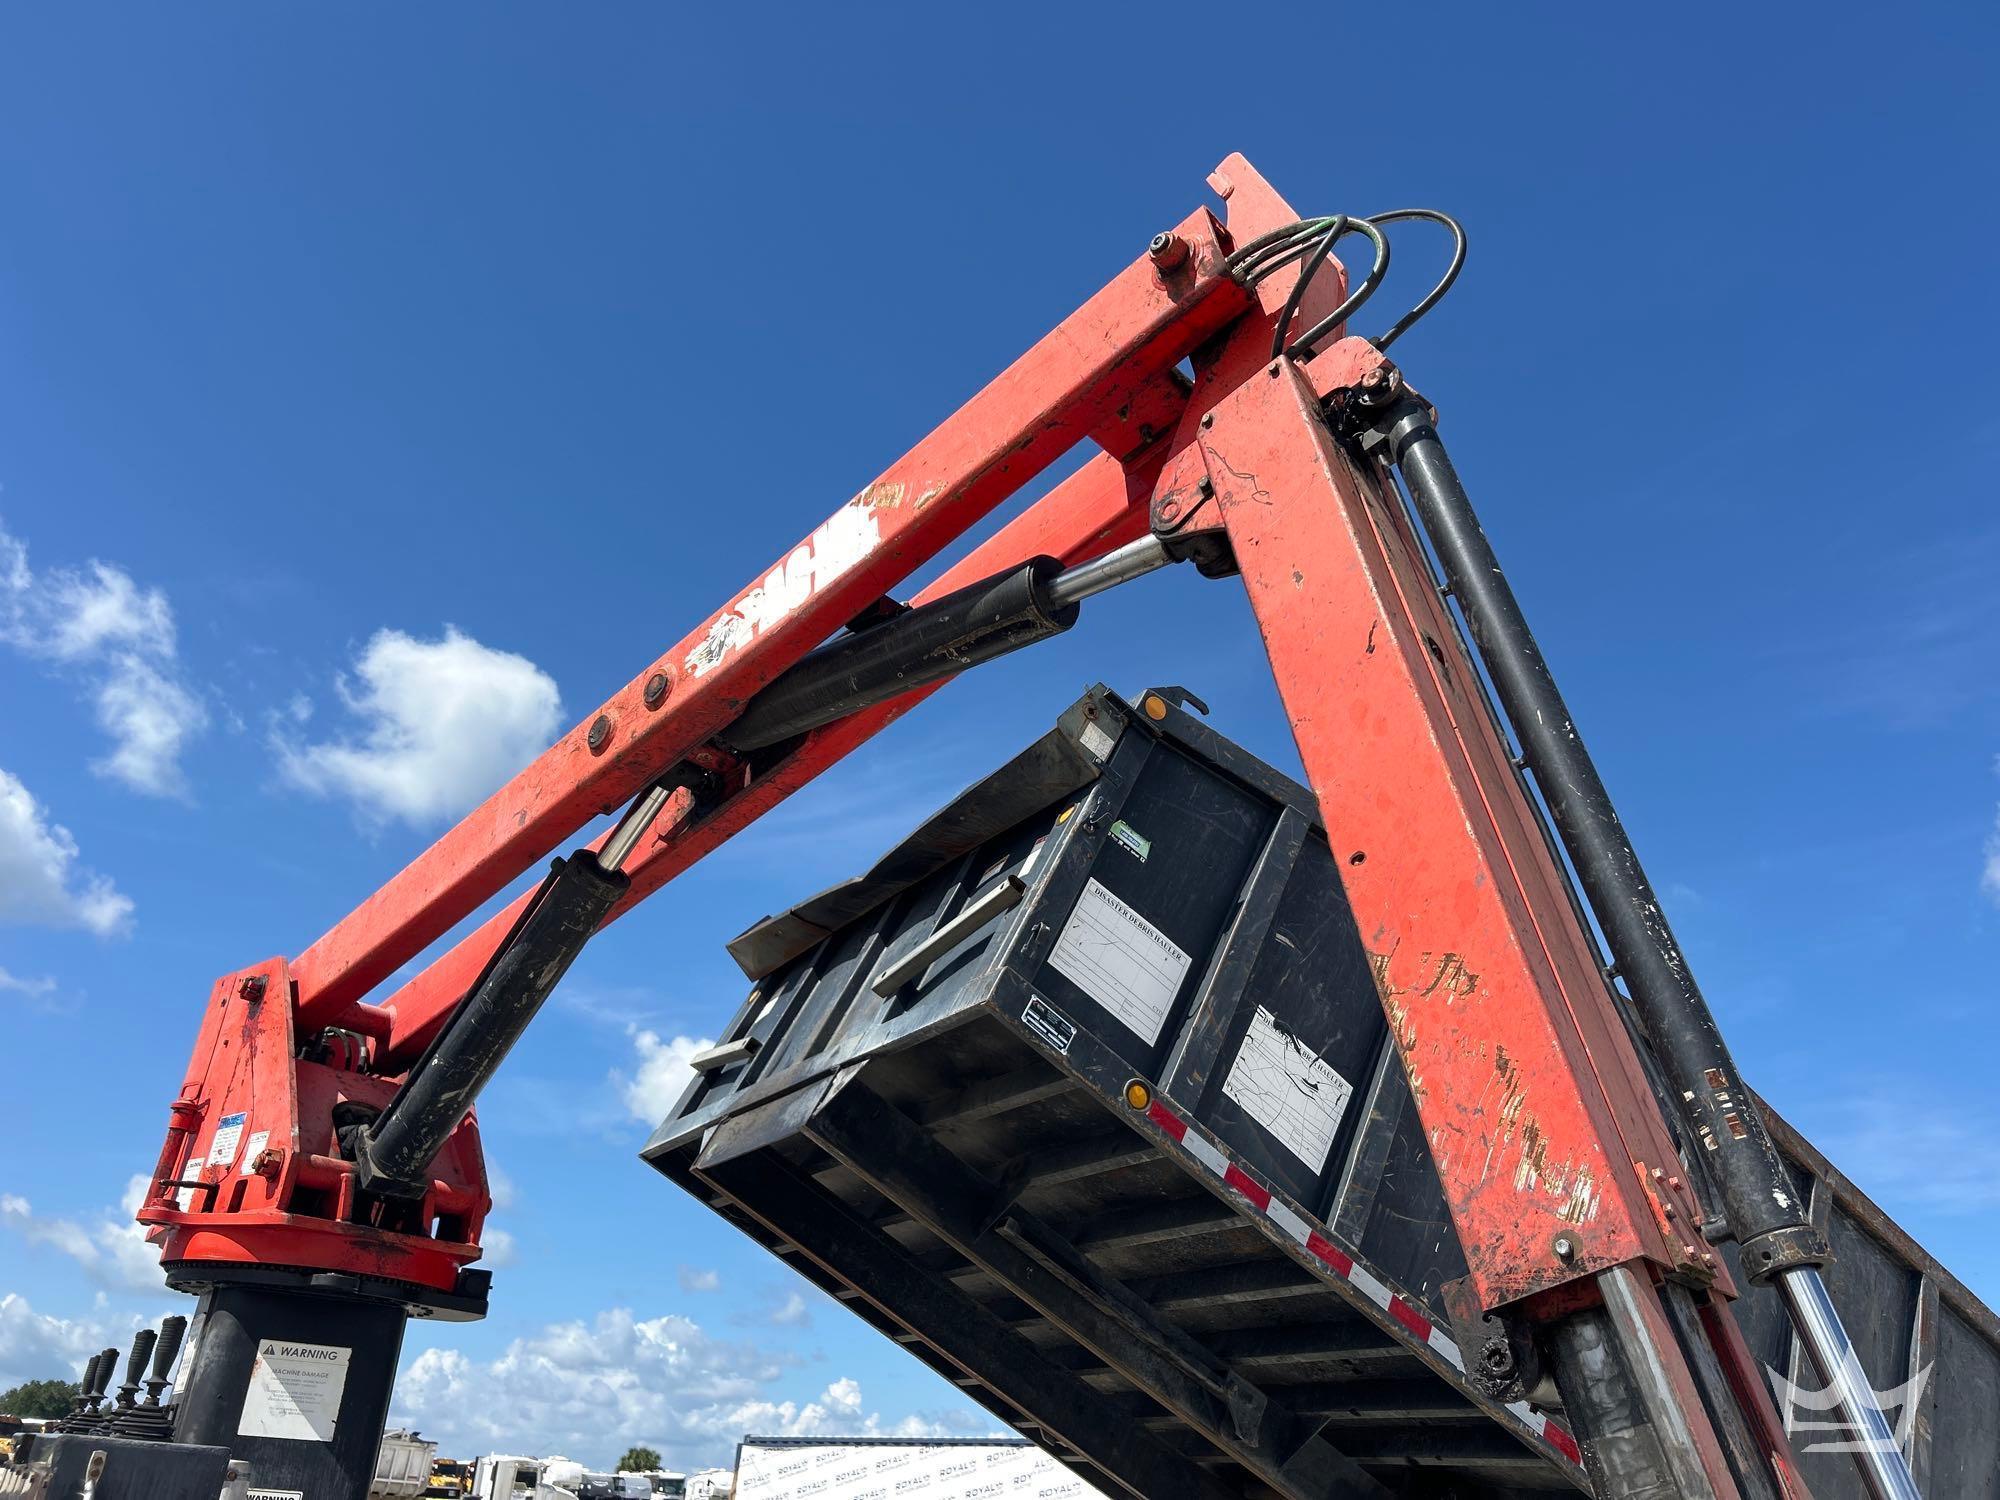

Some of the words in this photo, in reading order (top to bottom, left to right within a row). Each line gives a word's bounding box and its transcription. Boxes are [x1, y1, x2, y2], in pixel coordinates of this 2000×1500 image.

[1094, 887, 1128, 918] DISASTER
[1128, 914, 1154, 938] DEBRIS
[1154, 934, 1182, 961] HAULER
[1316, 1063, 1345, 1091] HAULER
[280, 1346, 338, 1361] WARNING
[272, 1368, 301, 1377] MACHINE
[301, 1371, 329, 1379] DAMAGE
[986, 1447, 1017, 1463] ROYAL
[940, 1463, 969, 1476] ROYAL
[895, 1476, 923, 1490] ROYAL
[965, 1484, 996, 1499] ROYAL
[1038, 1484, 1072, 1499] ROYAL
